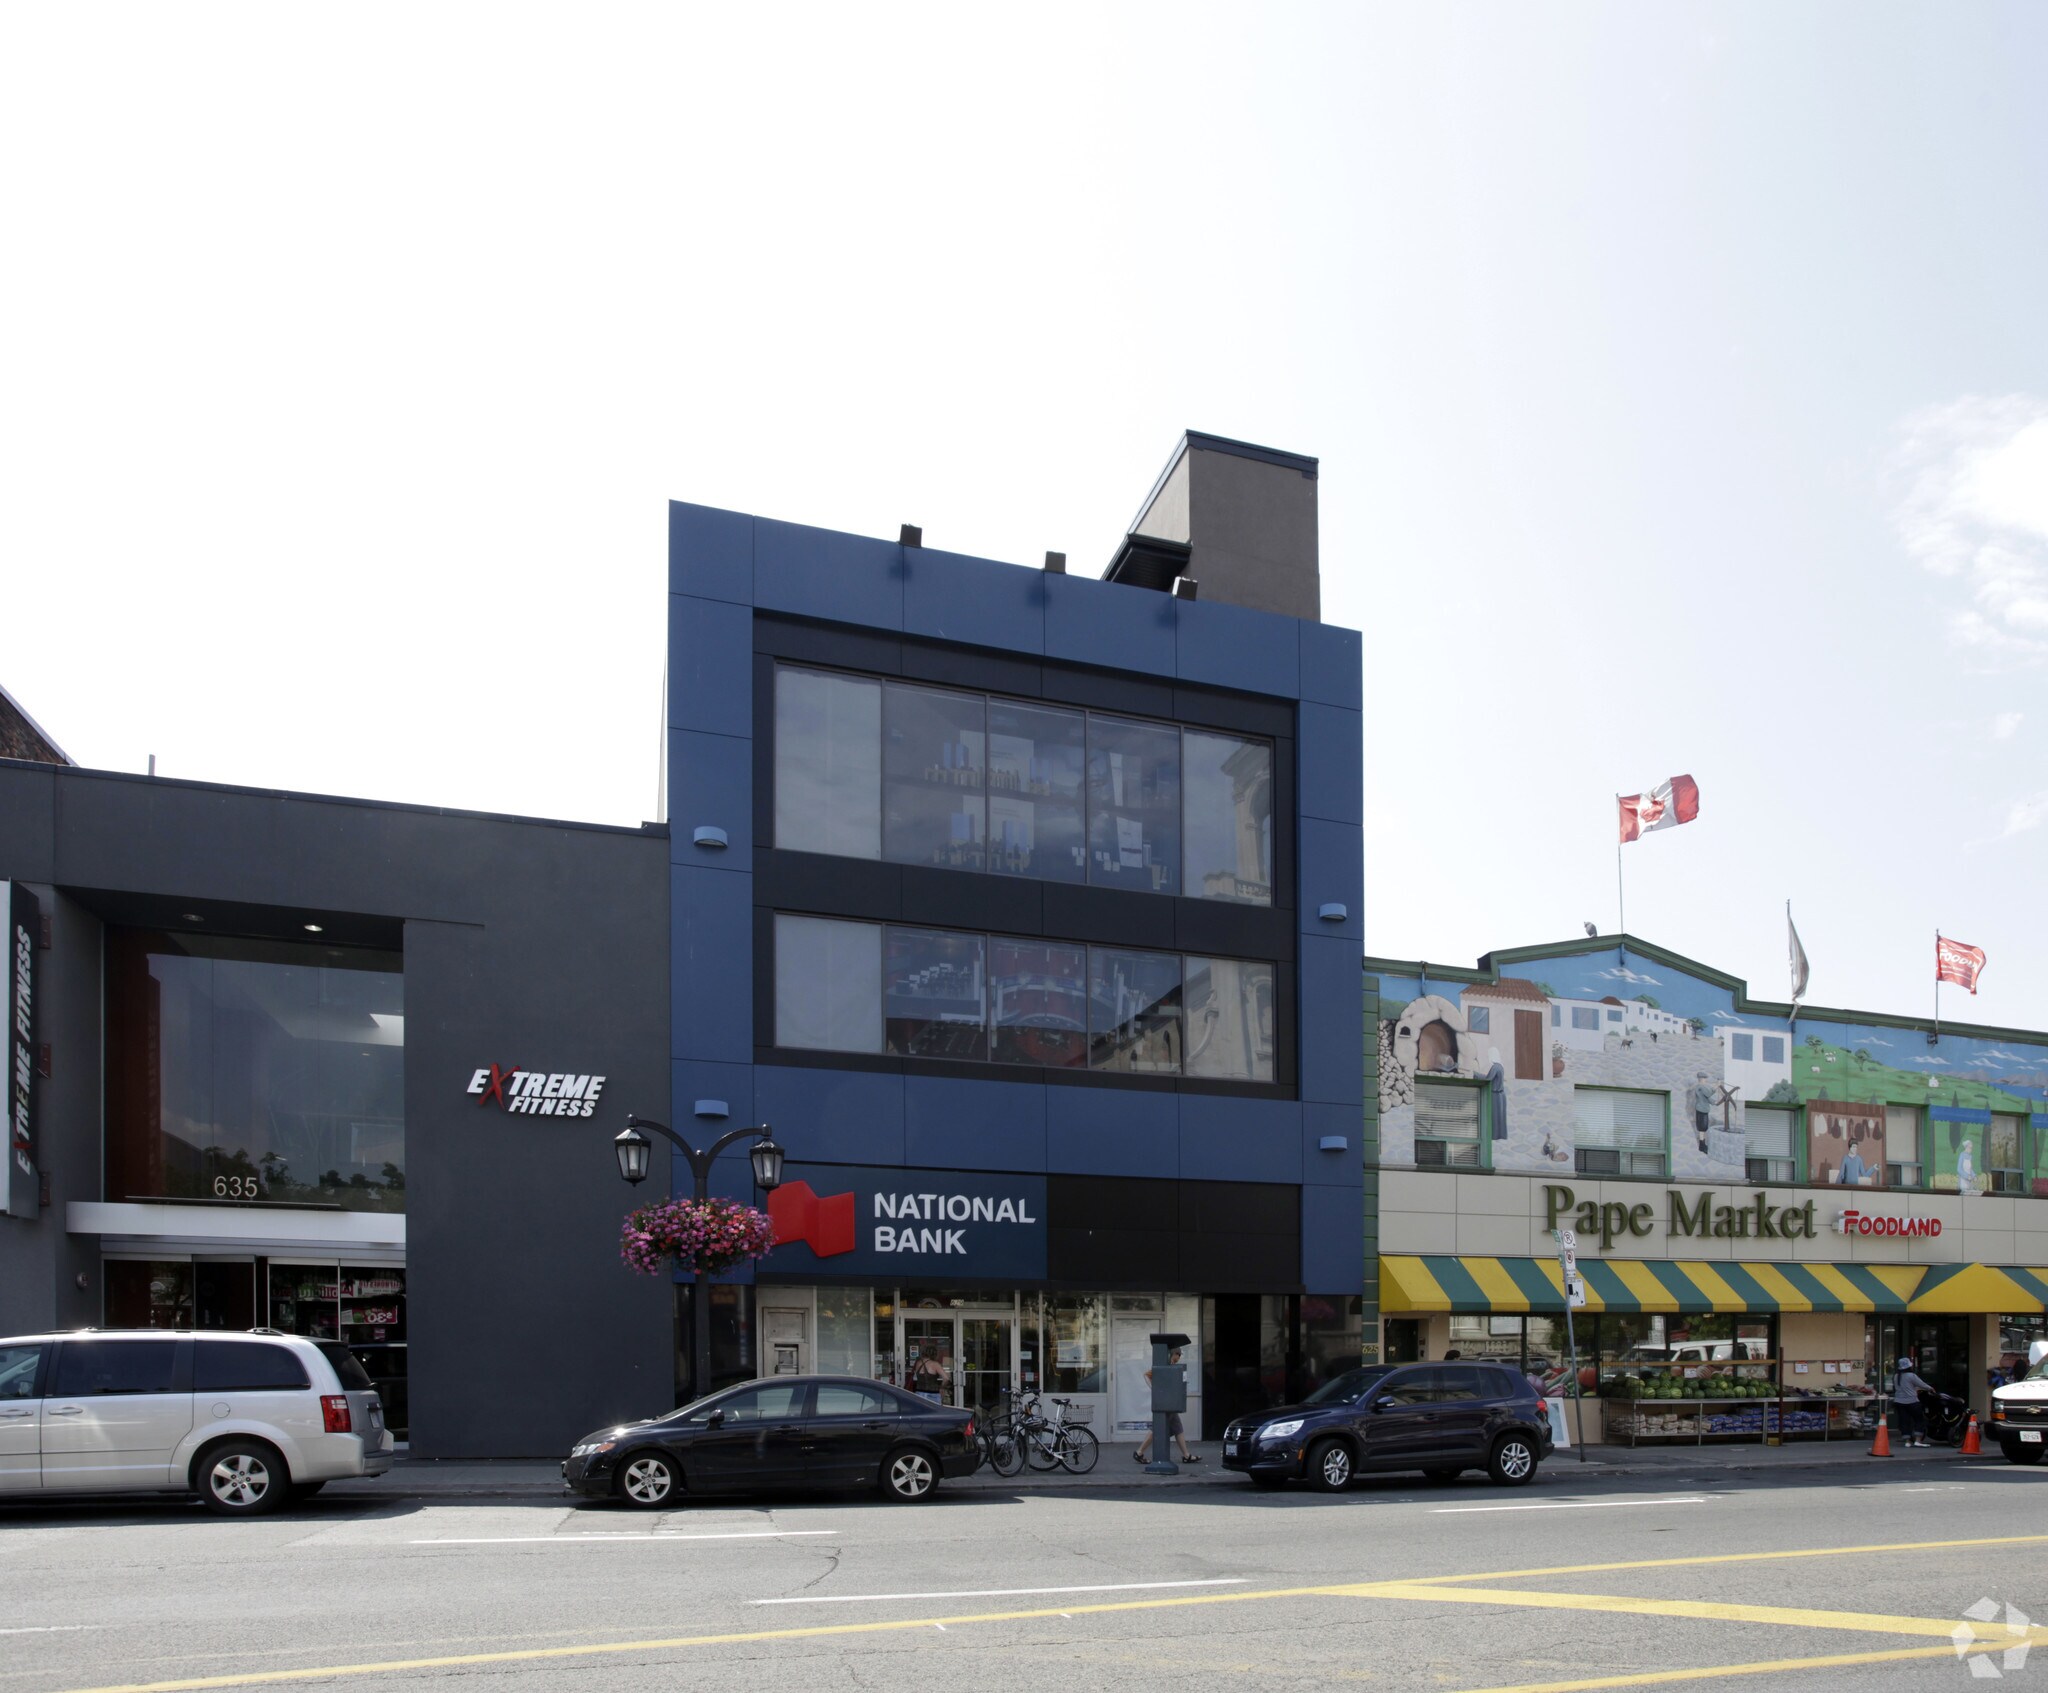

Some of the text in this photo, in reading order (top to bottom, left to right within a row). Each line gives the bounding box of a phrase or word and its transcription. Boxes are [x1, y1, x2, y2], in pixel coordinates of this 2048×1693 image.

[16, 925, 32, 1043] FITNESS
[467, 1063, 606, 1109] EXTREME
[508, 1097, 595, 1117] FITNESS
[214, 1176, 257, 1197] 635
[874, 1192, 1036, 1223] NATIONAL
[1543, 1185, 1818, 1249] Pape Market
[1843, 1210, 1942, 1237] FOODLAND
[874, 1226, 967, 1254] BANK
[1363, 1345, 1379, 1354] 625
[1852, 1361, 1864, 1369] 623
